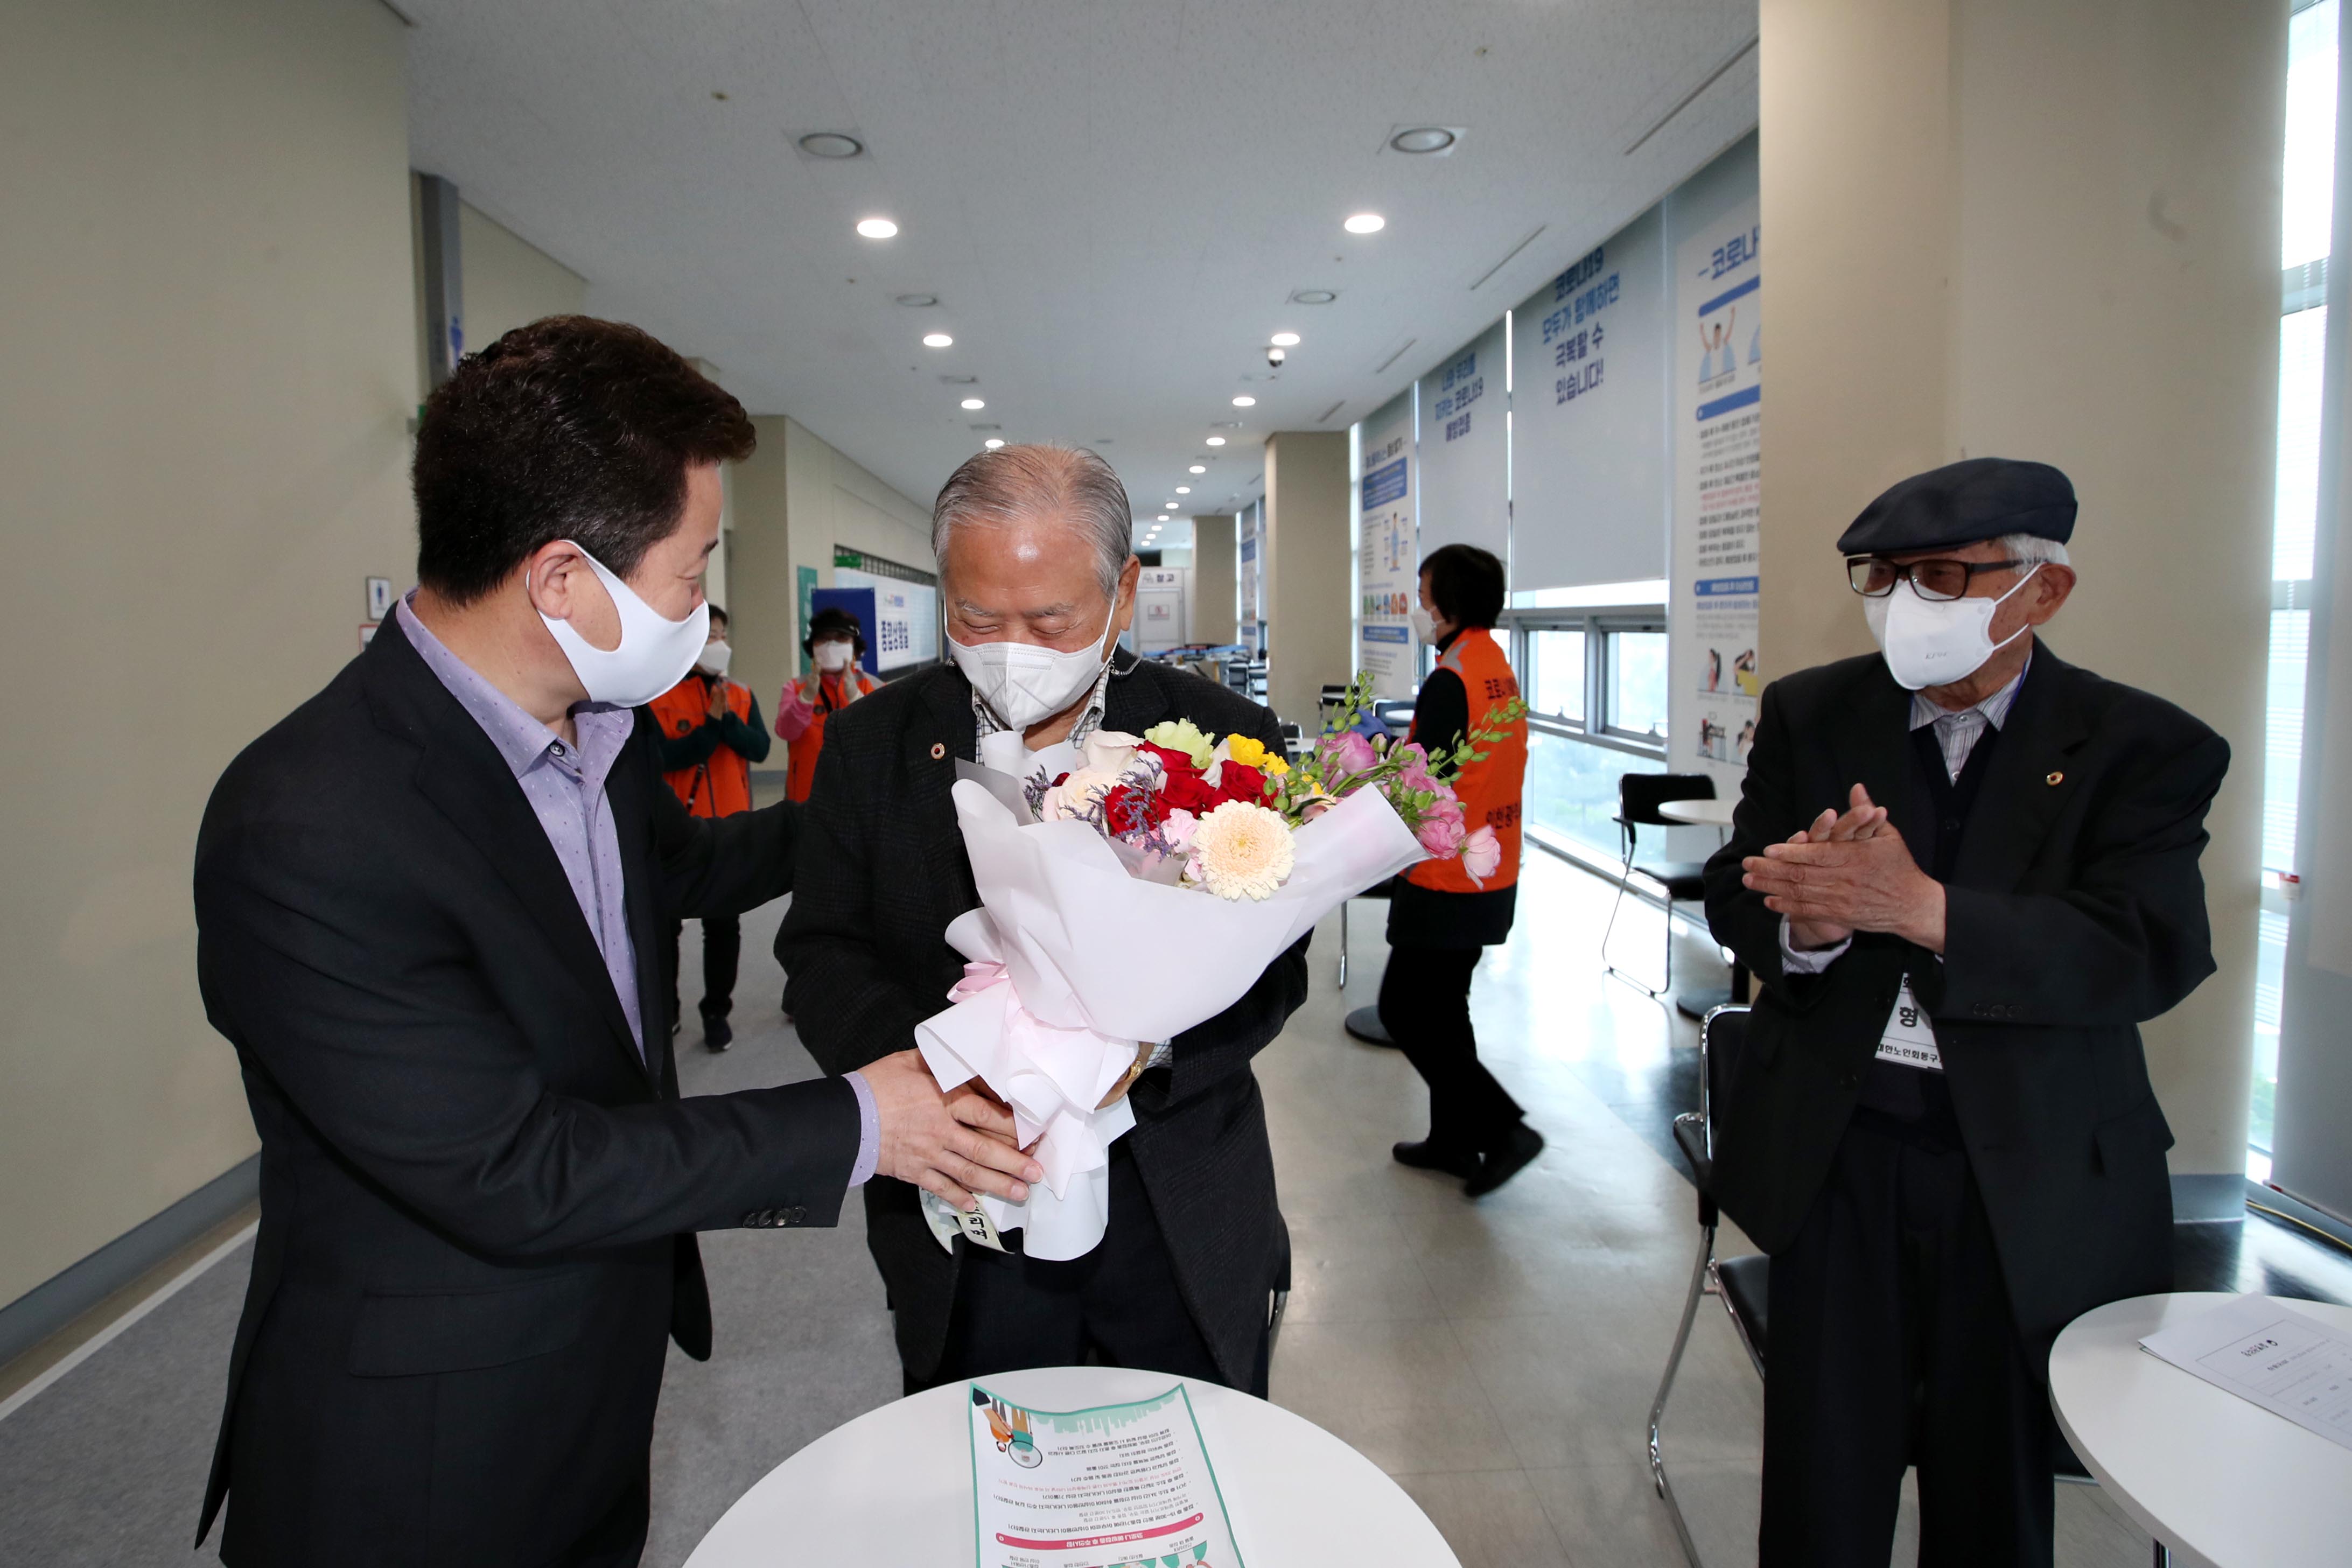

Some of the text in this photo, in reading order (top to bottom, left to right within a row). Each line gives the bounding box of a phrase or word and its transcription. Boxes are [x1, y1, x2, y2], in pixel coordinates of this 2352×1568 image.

[1542, 270, 1621, 345] 모두가 함께하면
[1555, 321, 1604, 368] 극복할 수
[1455, 375, 1484, 411] 코로나19
[1556, 358, 1605, 406] 있습니다!
